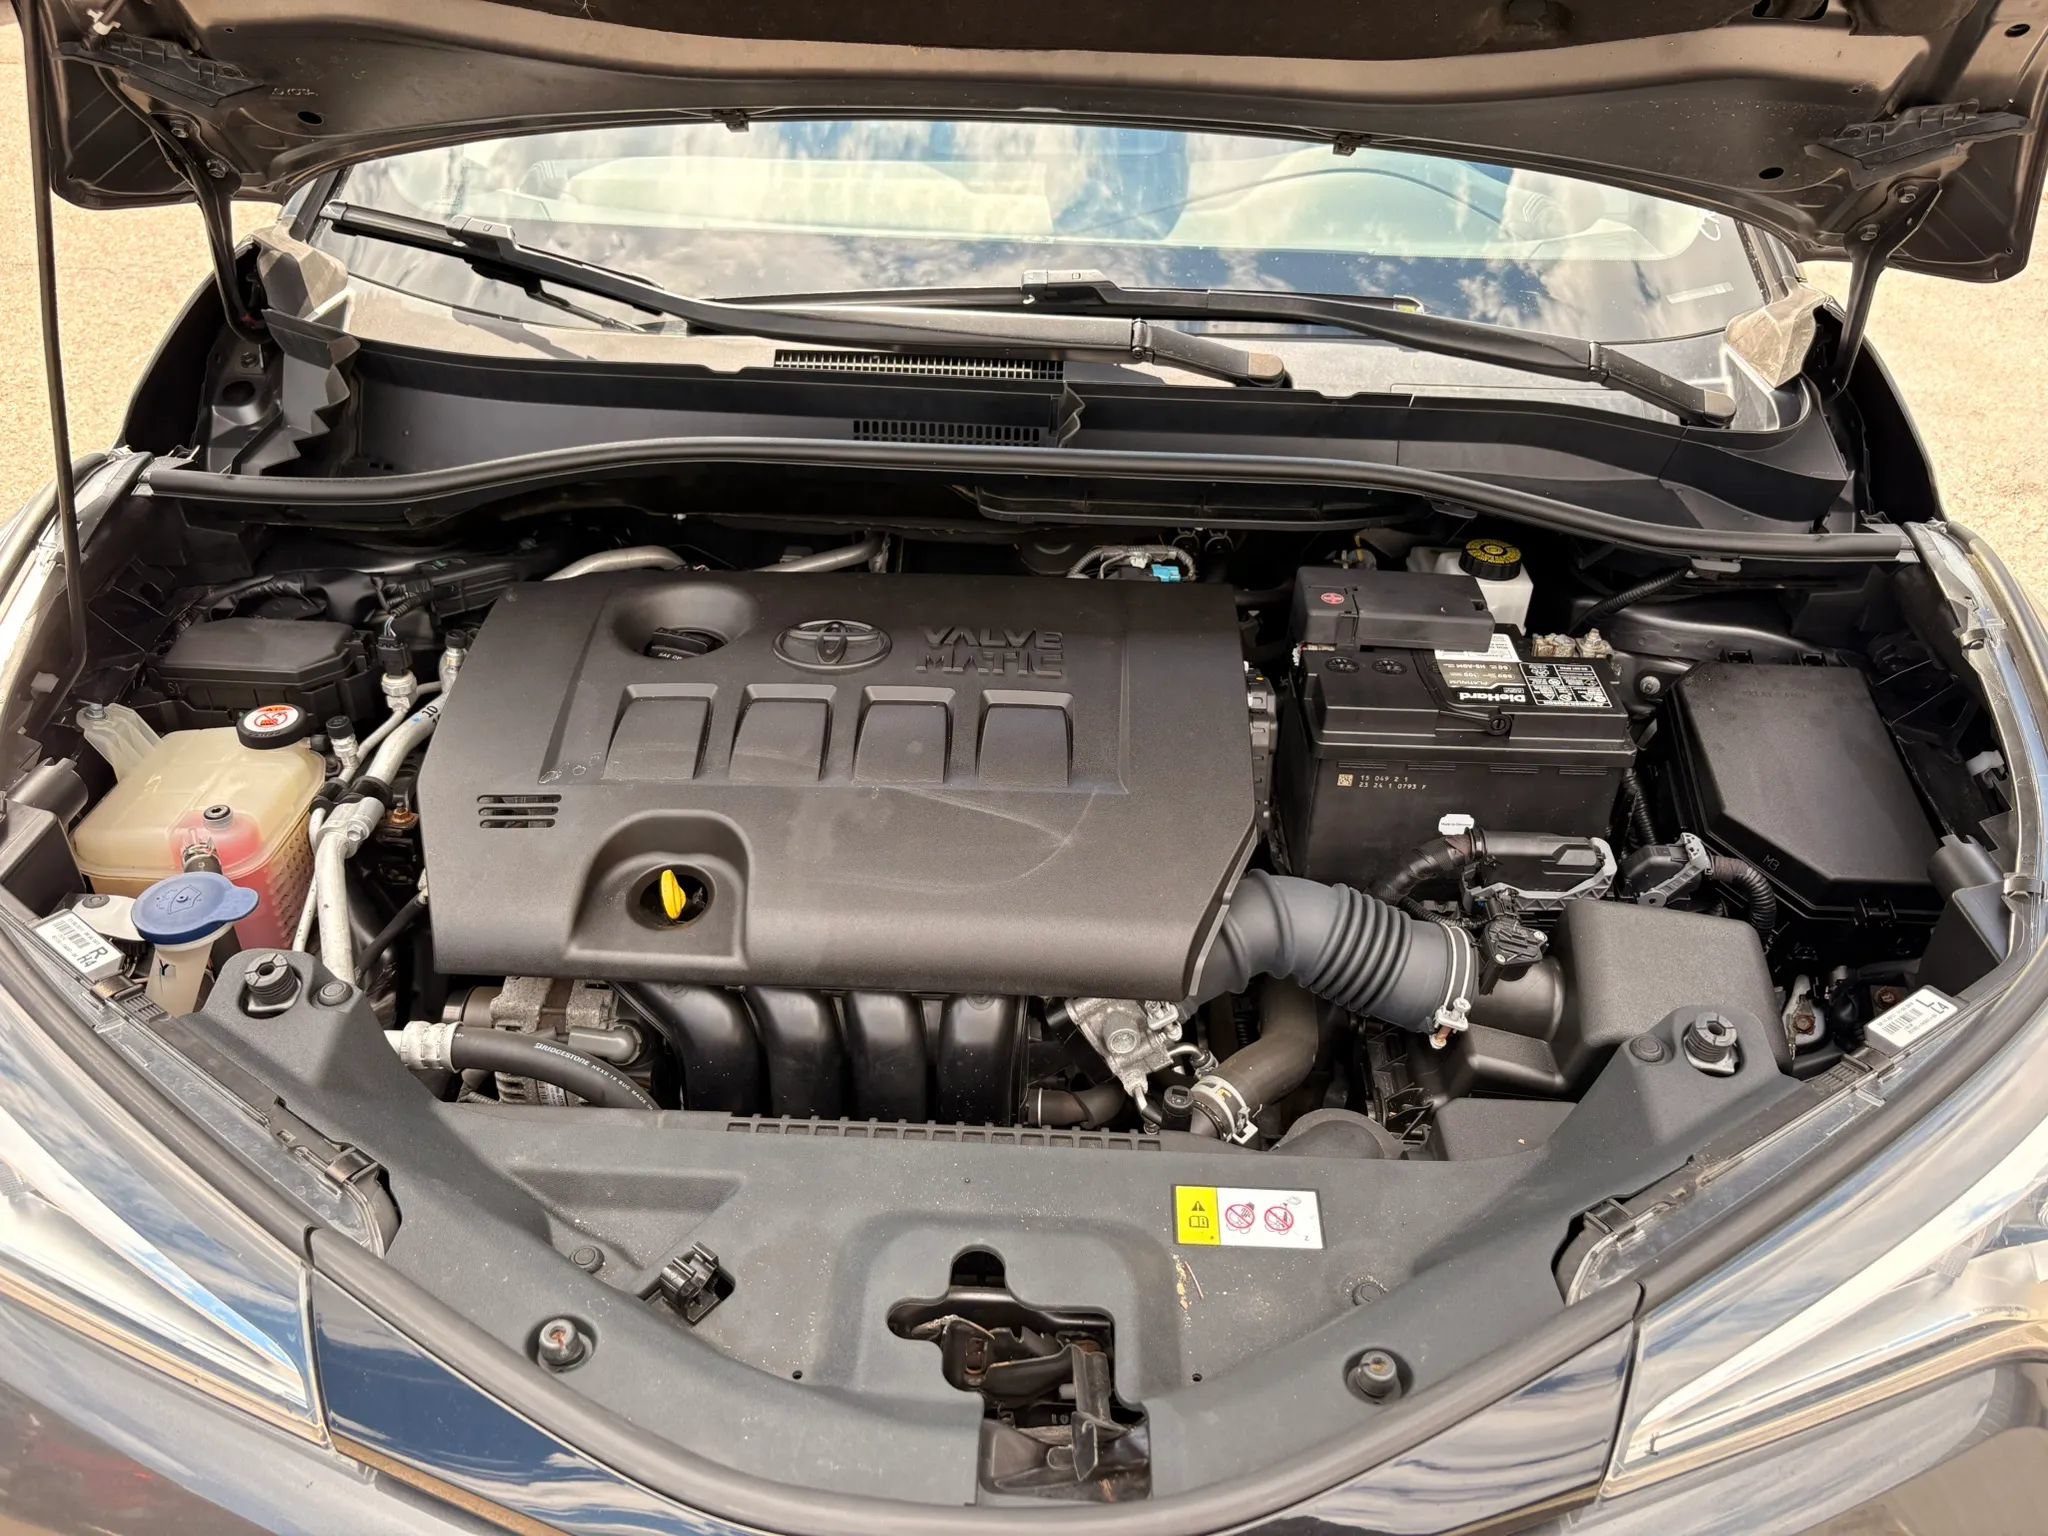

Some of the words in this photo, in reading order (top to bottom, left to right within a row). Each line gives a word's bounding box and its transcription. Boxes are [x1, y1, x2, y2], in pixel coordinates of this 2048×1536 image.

[922, 628, 1064, 650] VALVE
[915, 649, 1064, 676] MATIC
[1459, 692, 1526, 703] DieHard
[422, 705, 438, 718] 10
[88, 946, 109, 960] R
[77, 953, 97, 968] H4
[1915, 998, 1935, 1008] L
[534, 1042, 590, 1066] BRIDGESTONE
[631, 1090, 648, 1104] MADE
